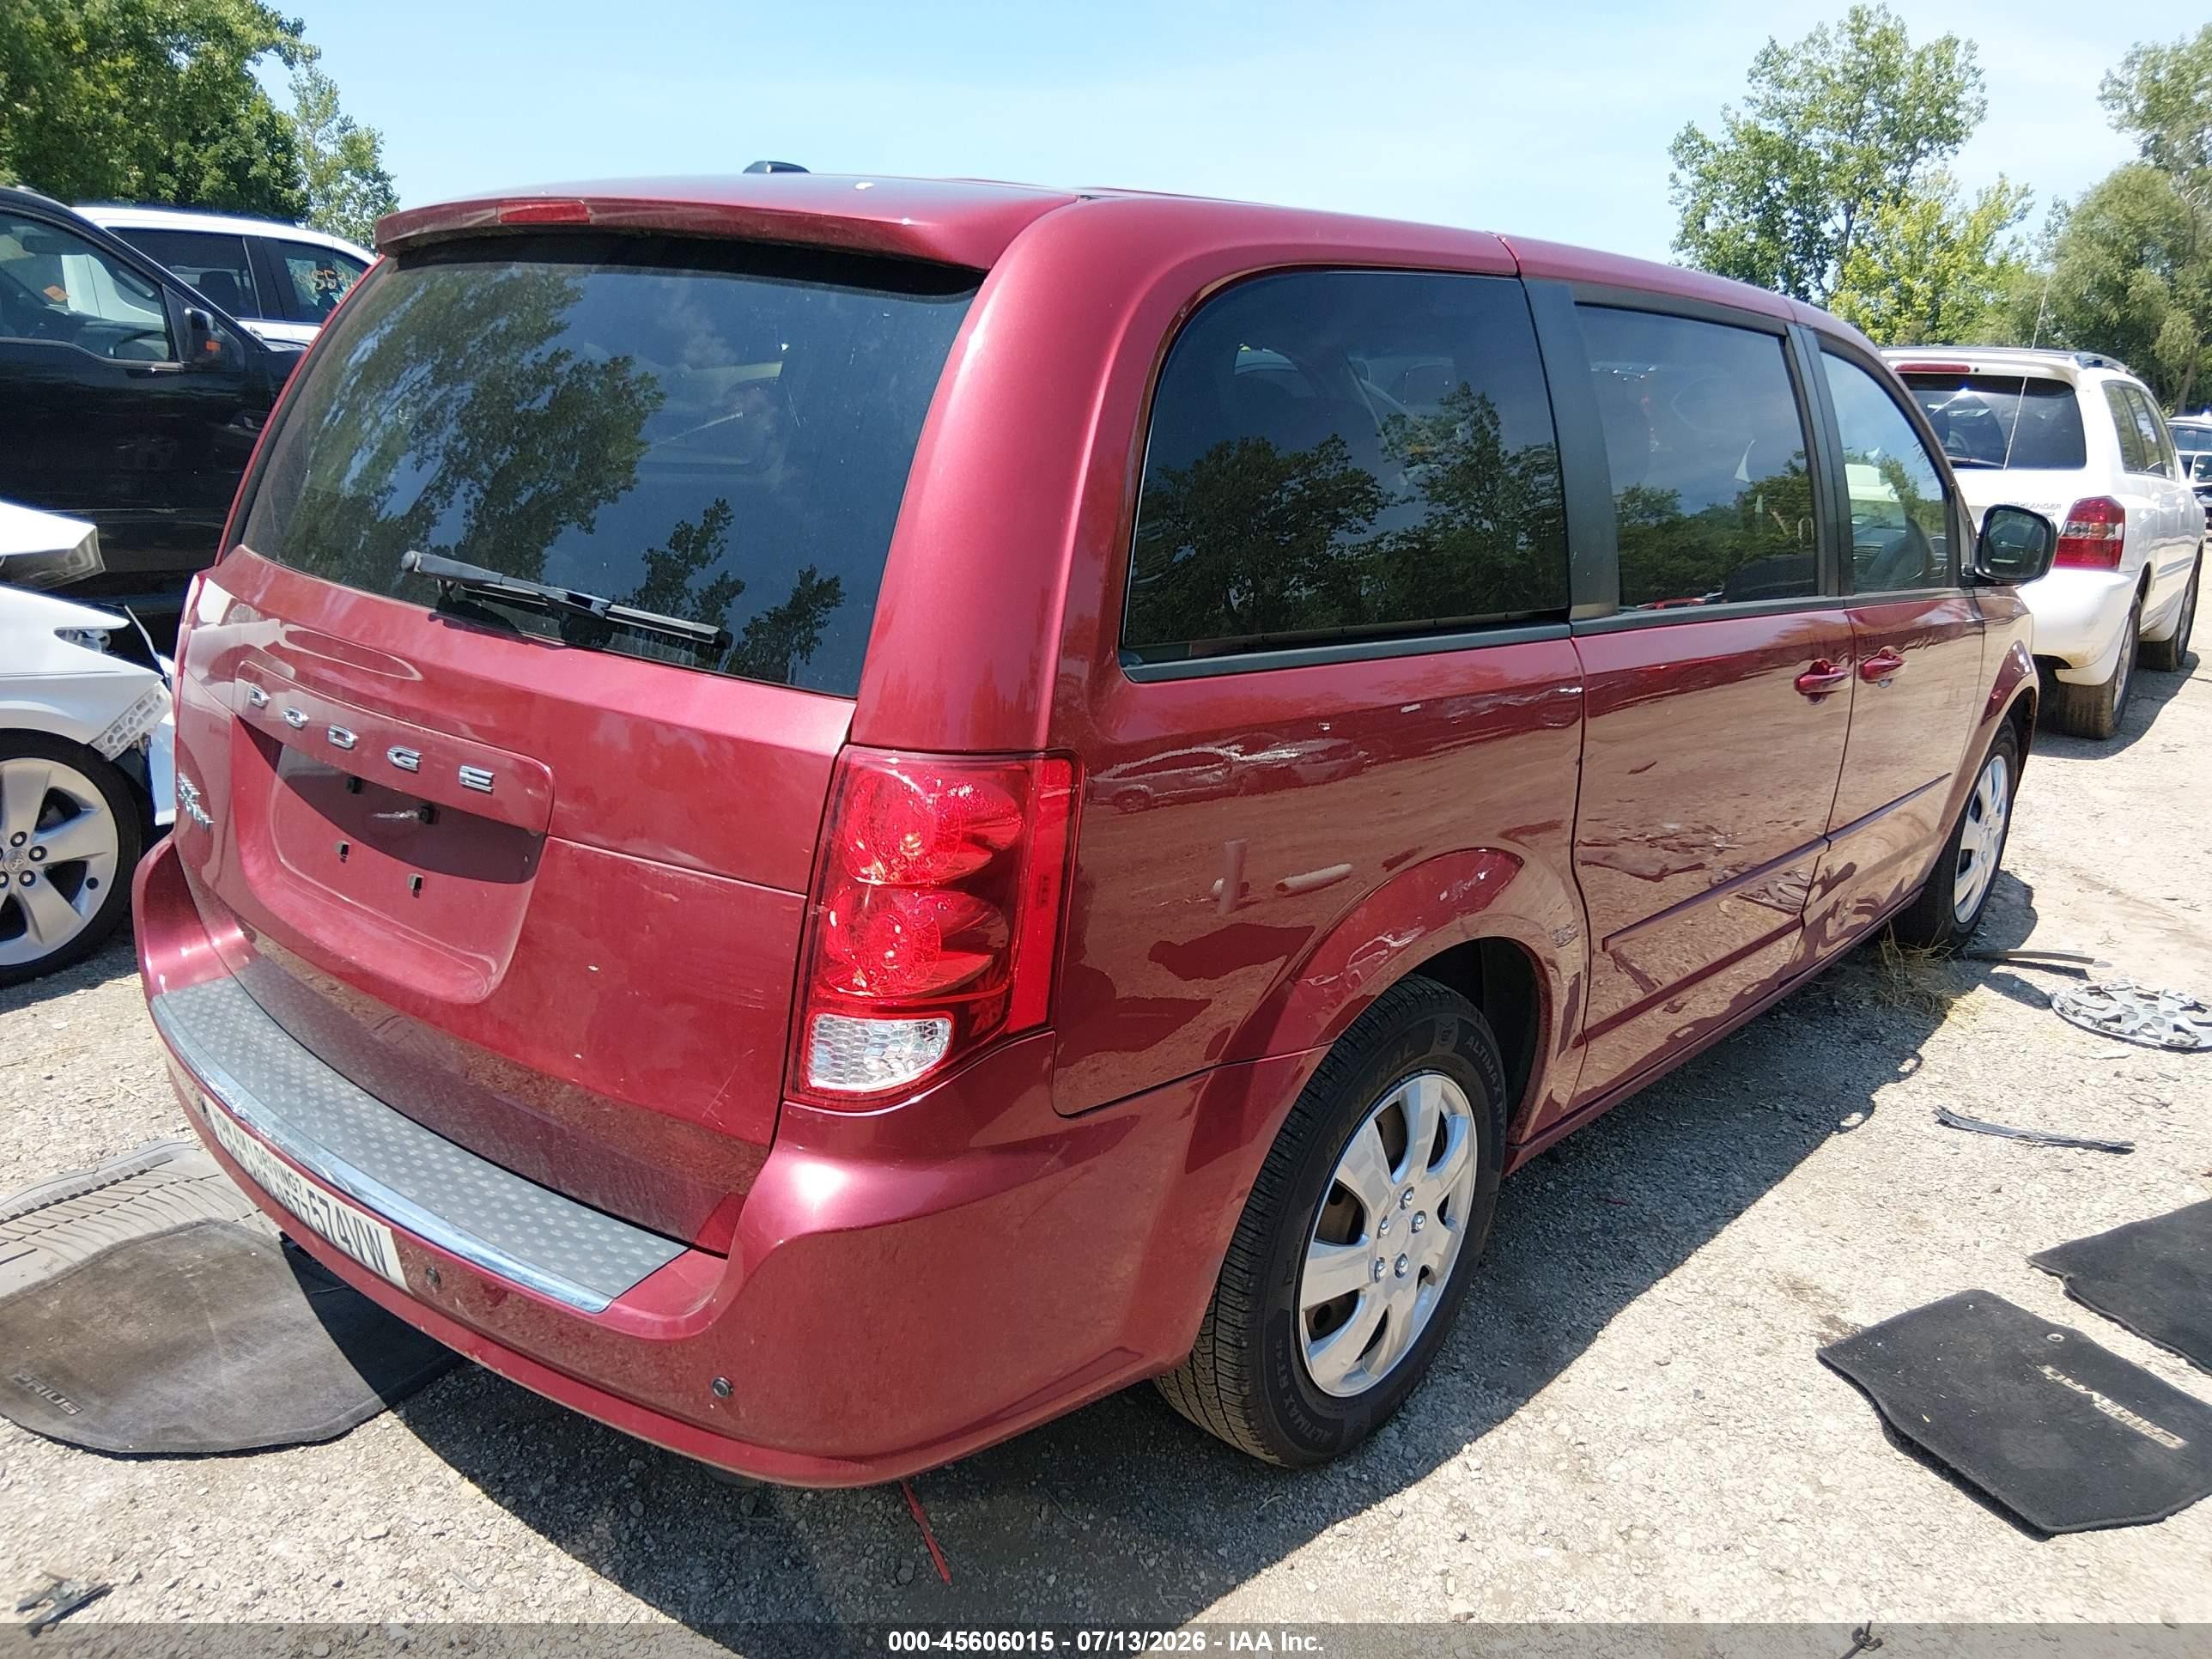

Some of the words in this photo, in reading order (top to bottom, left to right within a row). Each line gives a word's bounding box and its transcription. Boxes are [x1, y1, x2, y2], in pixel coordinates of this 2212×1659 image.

[249, 684, 495, 793] DODGE
[1464, 1036, 1502, 1094] ALTIMAX
[307, 1188, 391, 1277] 574VW
[11, 1373, 83, 1415] PRIUS
